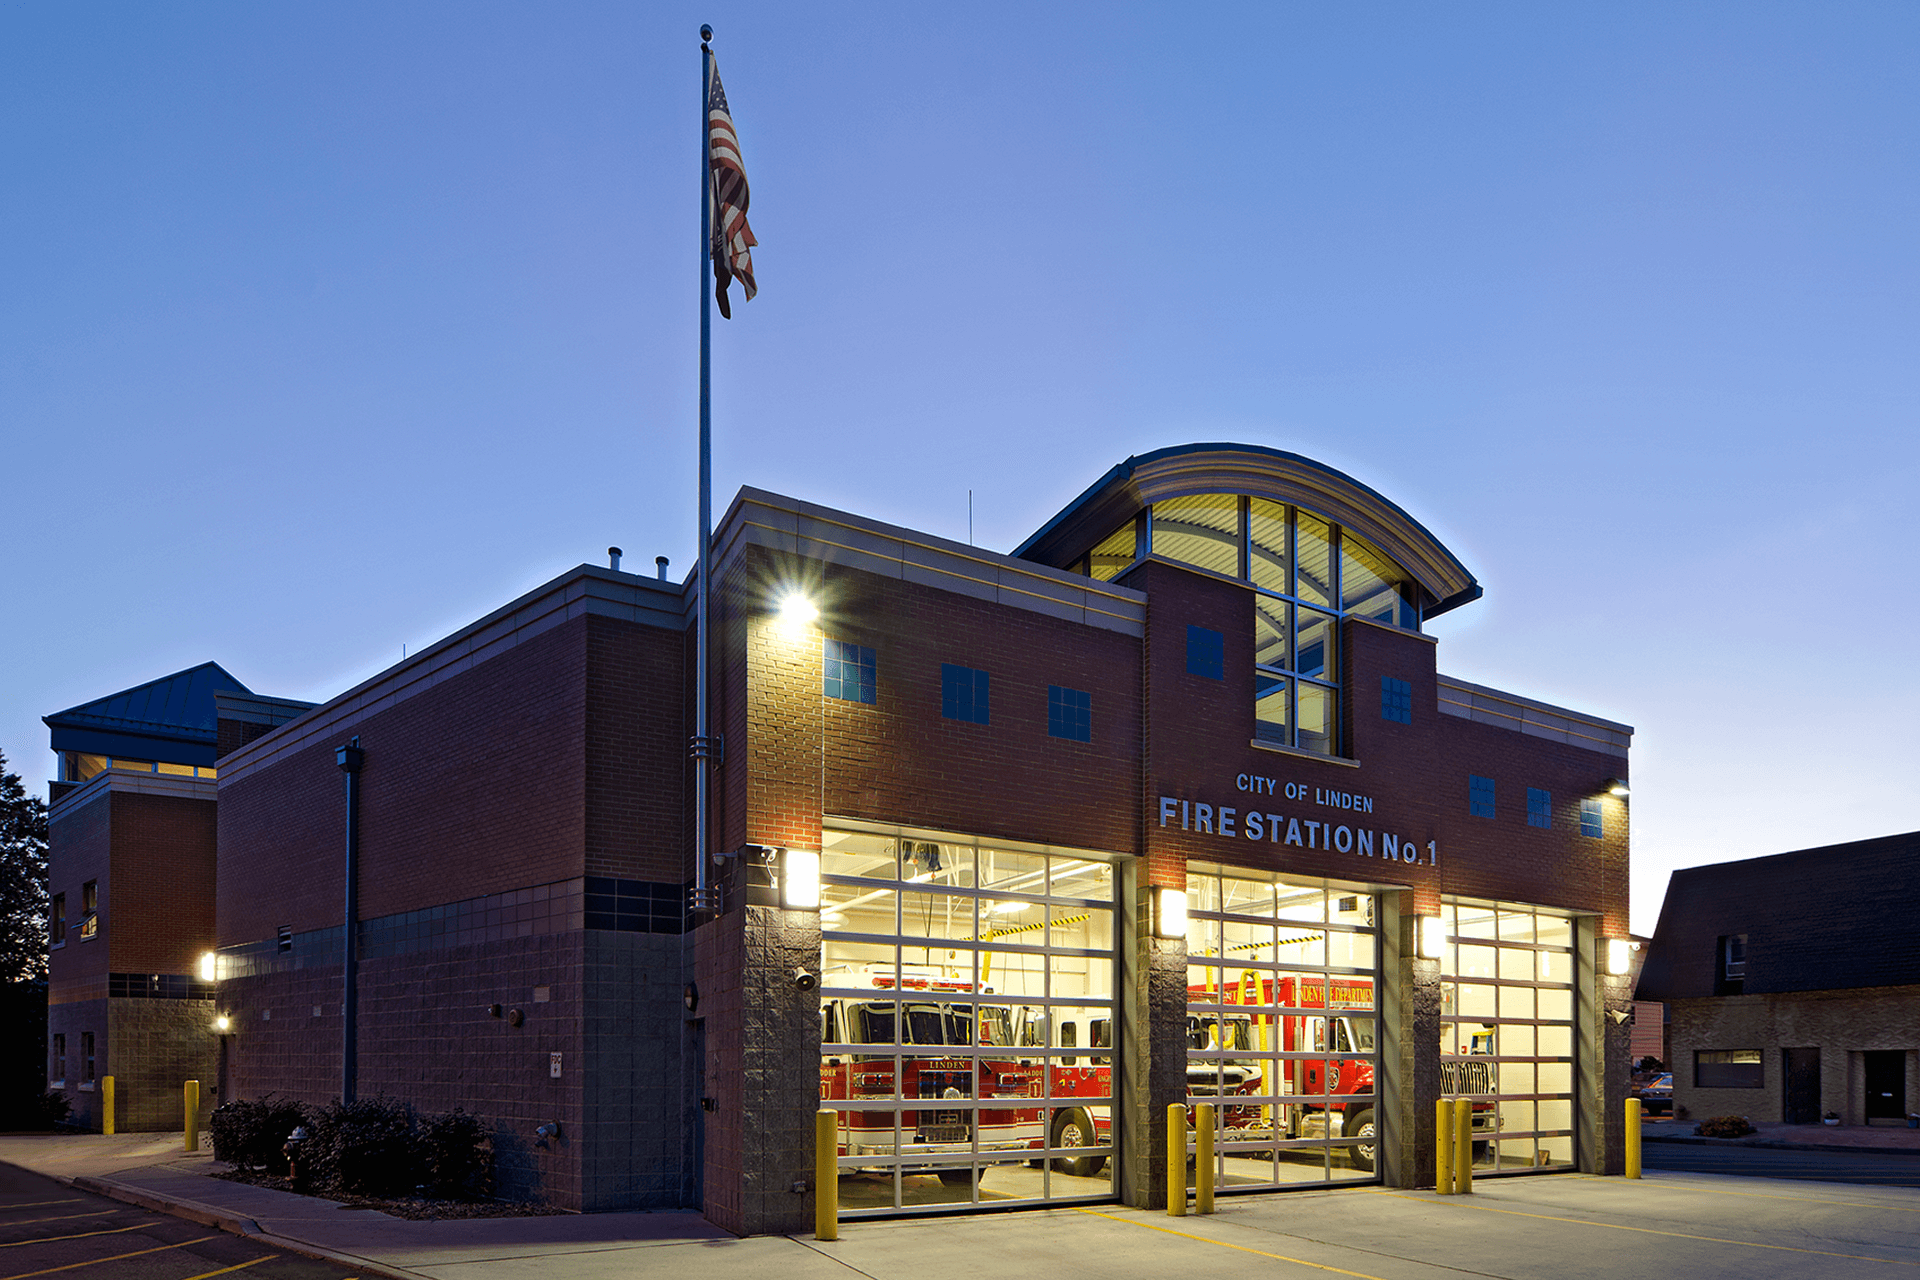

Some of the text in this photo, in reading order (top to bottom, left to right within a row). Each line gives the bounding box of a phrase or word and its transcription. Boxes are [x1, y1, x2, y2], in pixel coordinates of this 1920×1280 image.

[1236, 773, 1373, 814] CITY OF LINDEN
[1160, 796, 1236, 837] FIRE
[1245, 811, 1374, 858] STATION
[1292, 985, 1318, 1002] LNDEN
[1335, 987, 1374, 1002] DEPARTMEN
[551, 1054, 562, 1065] FDC
[929, 1061, 966, 1069] LINDEN
[820, 1068, 837, 1077] DDER
